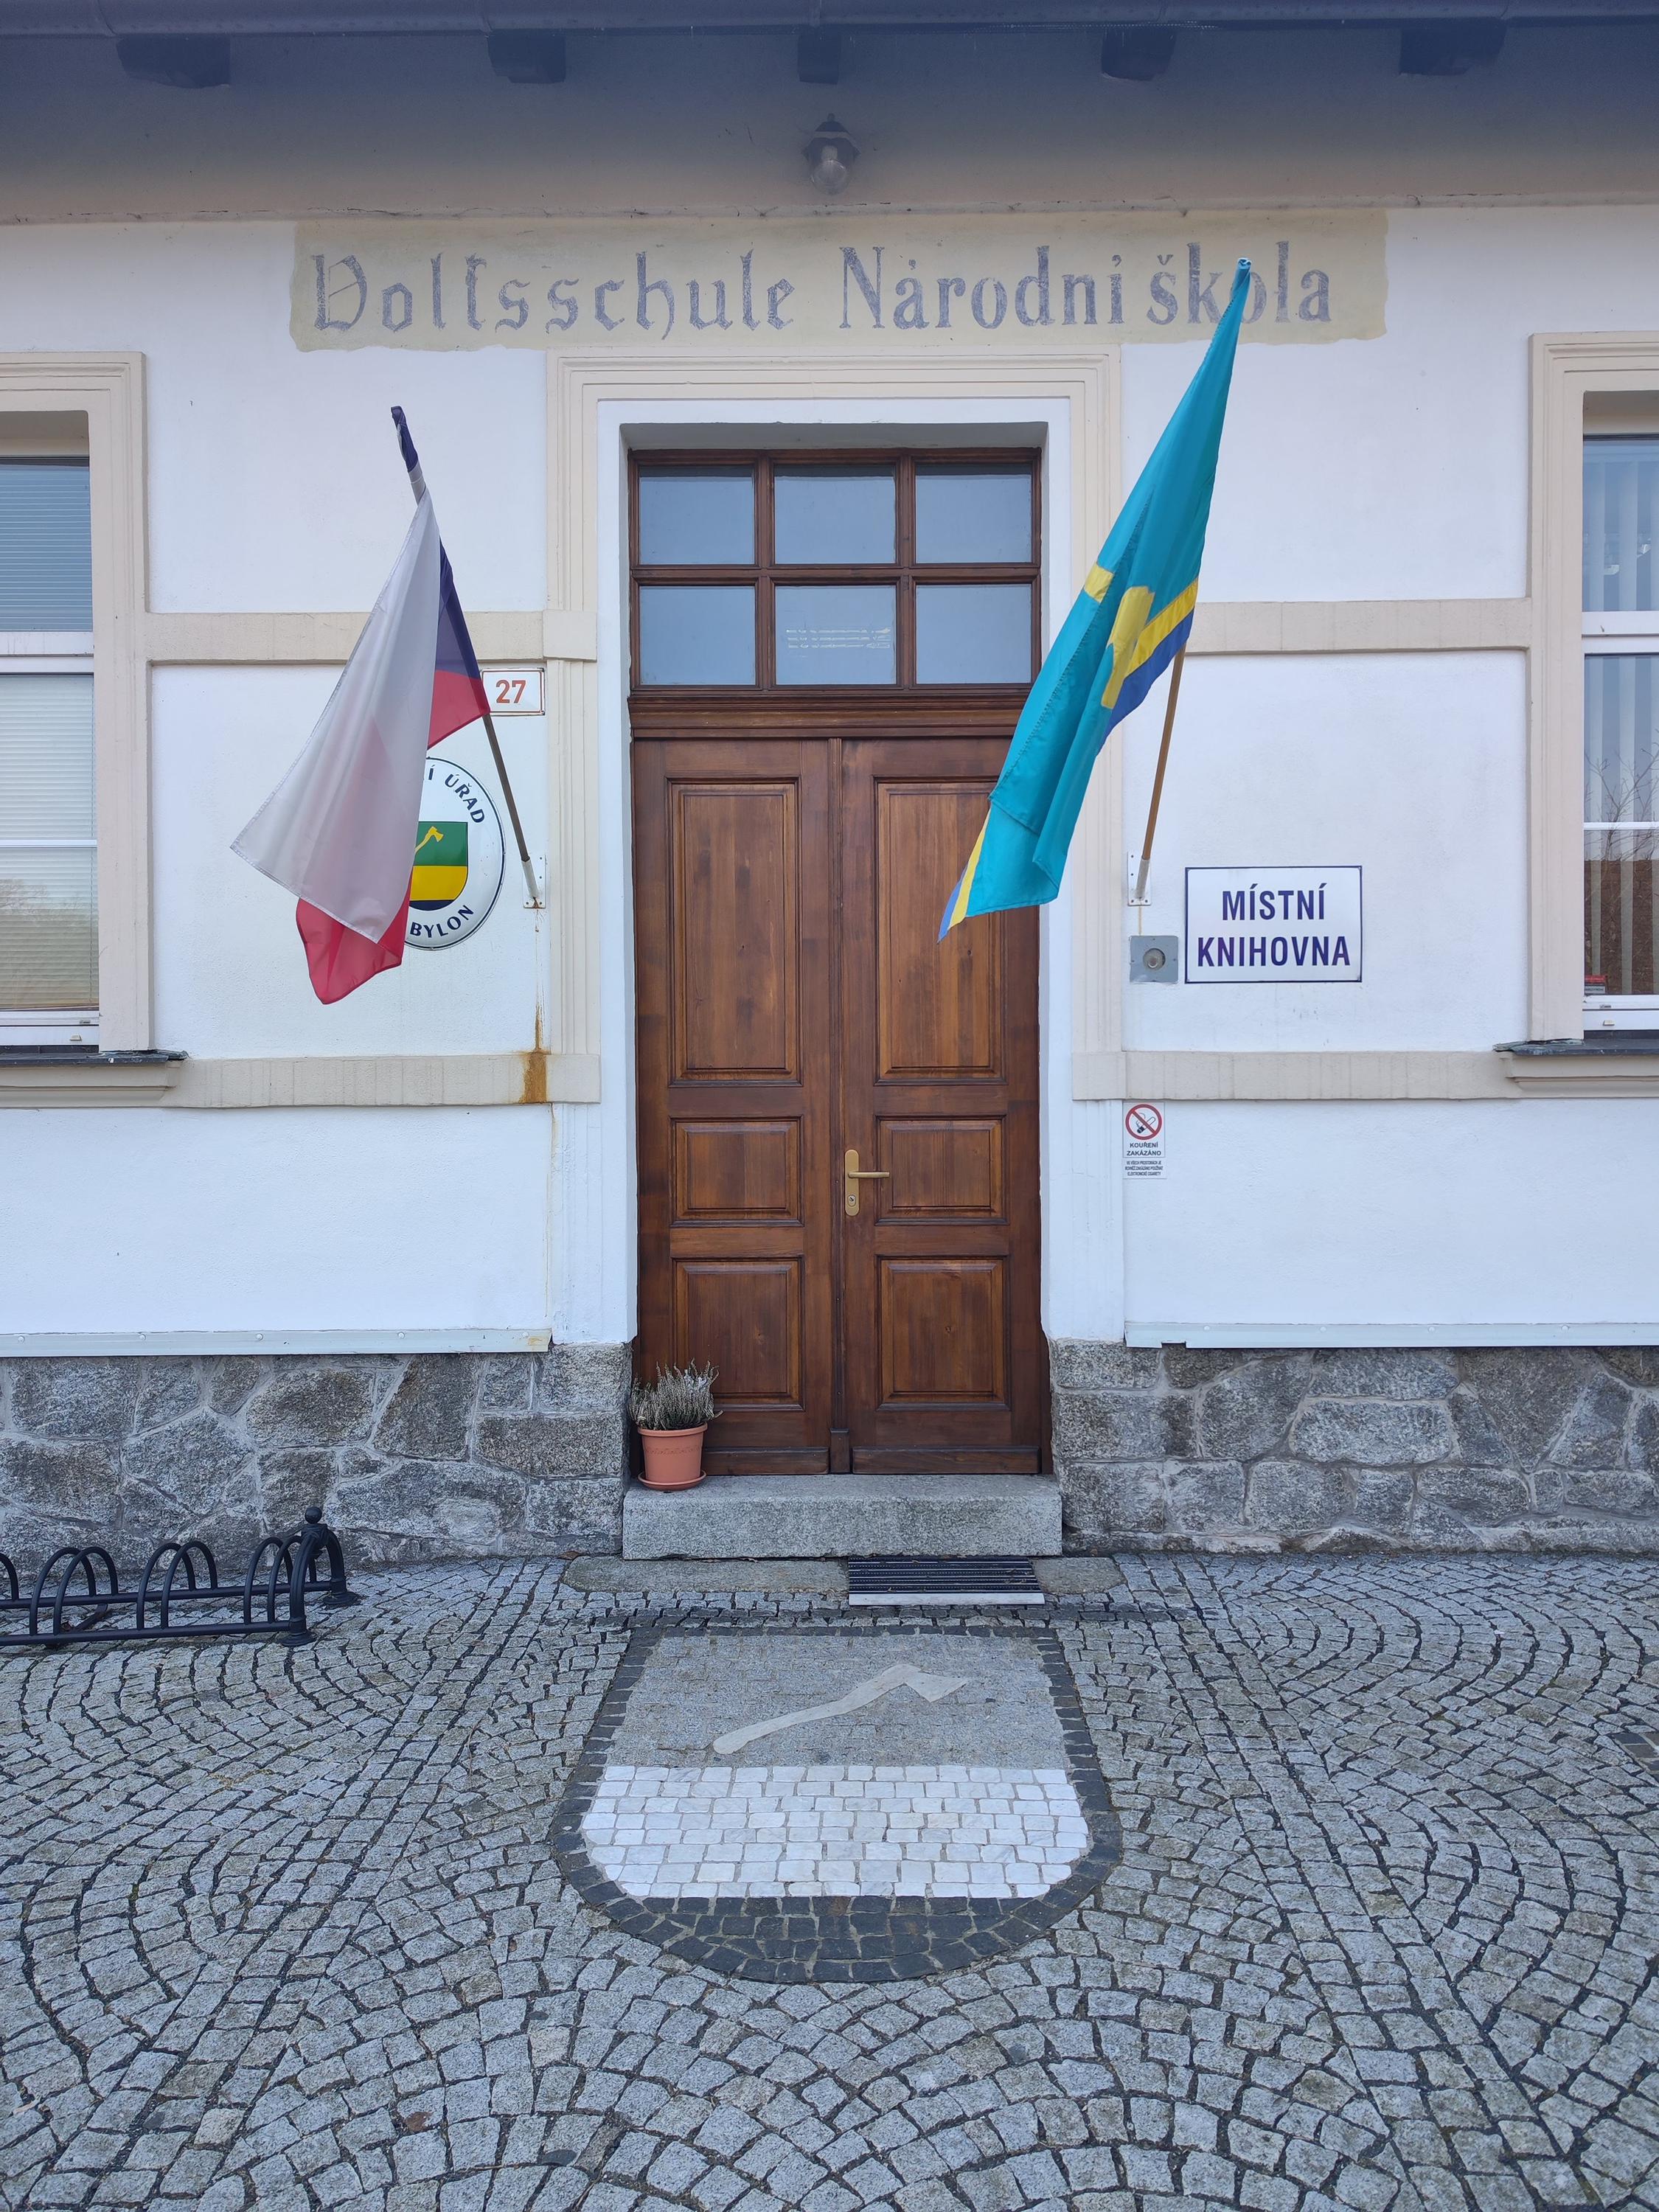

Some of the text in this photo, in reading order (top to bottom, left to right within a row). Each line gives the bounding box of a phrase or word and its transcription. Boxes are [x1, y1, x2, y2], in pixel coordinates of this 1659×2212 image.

[495, 679, 526, 704] 27
[445, 773, 485, 824] ÚŘAD
[1222, 883, 1327, 921] MÍSTNÍ
[409, 904, 474, 939] BYLON
[1197, 936, 1351, 967] KNIHOVNA
